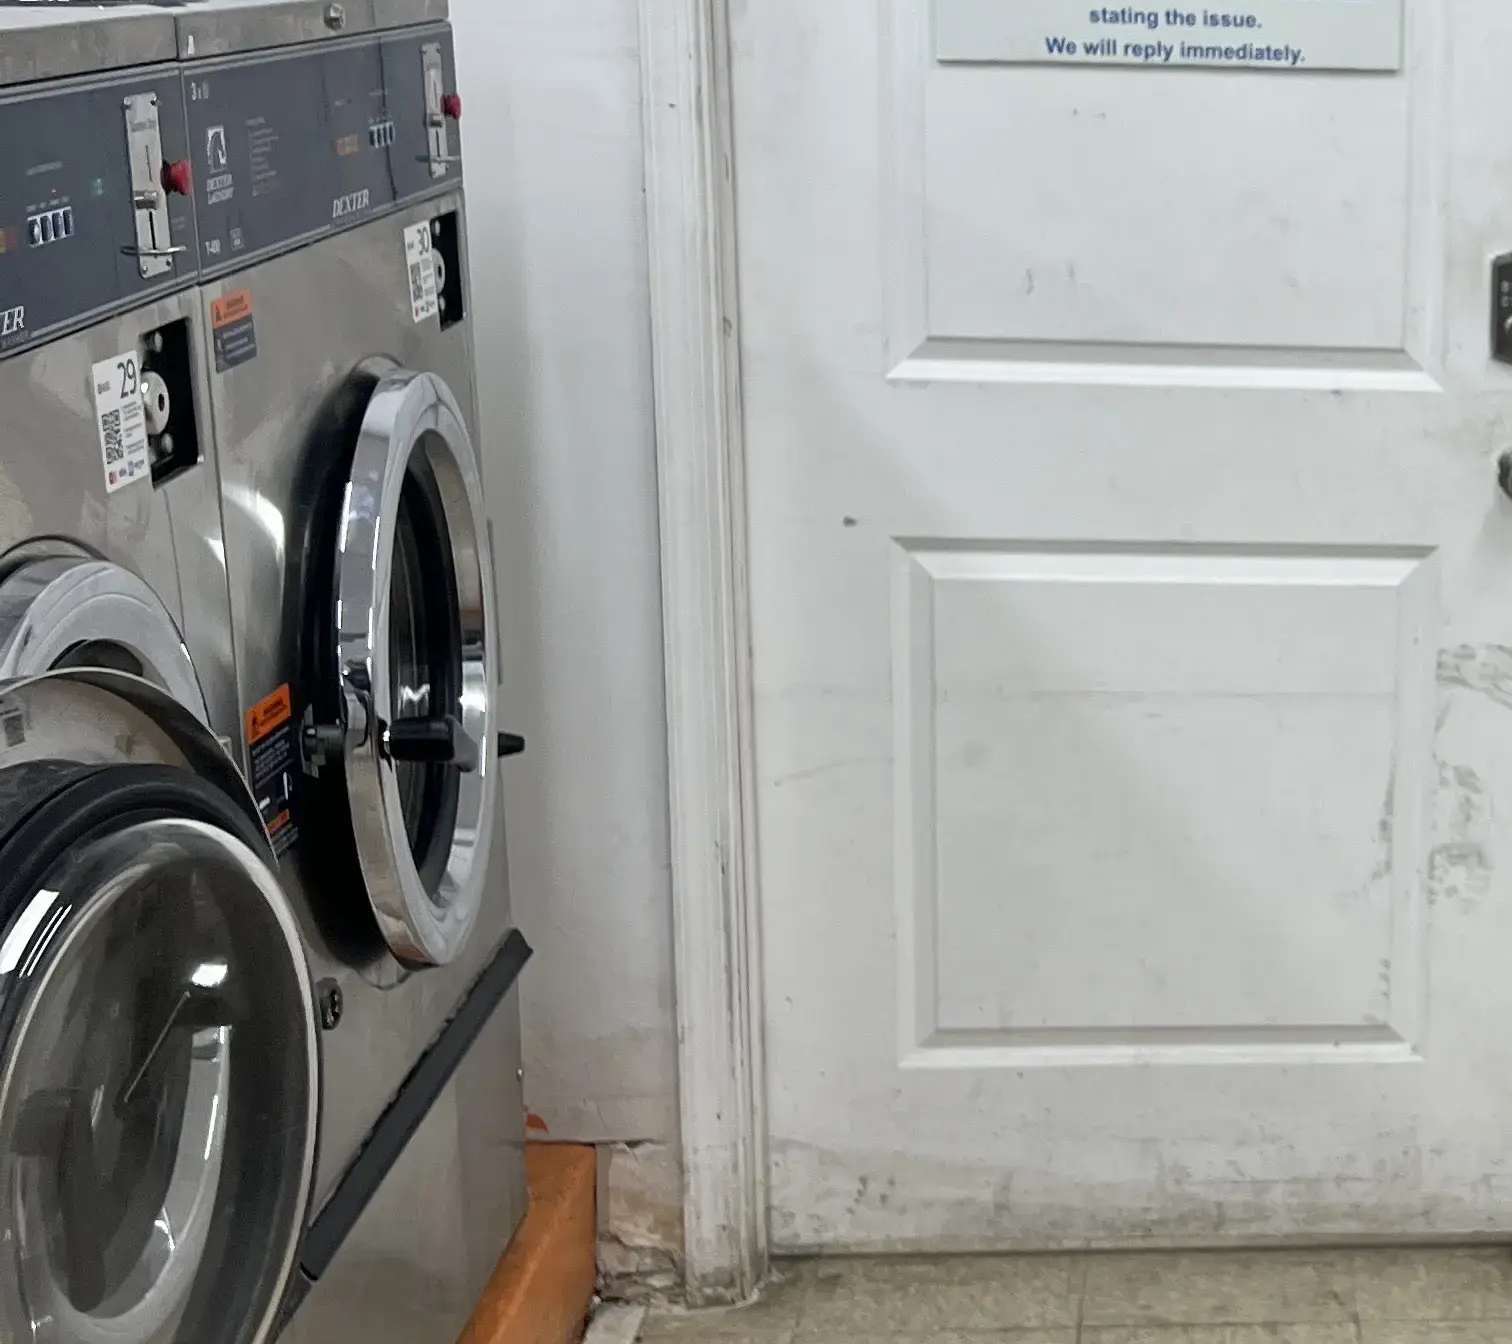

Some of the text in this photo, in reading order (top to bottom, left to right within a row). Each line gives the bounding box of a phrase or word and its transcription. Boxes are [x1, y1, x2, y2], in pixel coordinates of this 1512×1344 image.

[1089, 7, 1263, 29] stating the issue.
[1045, 36, 1305, 66] We will reply immediately.
[332, 188, 370, 218] DEXTER
[117, 358, 137, 399] 29
